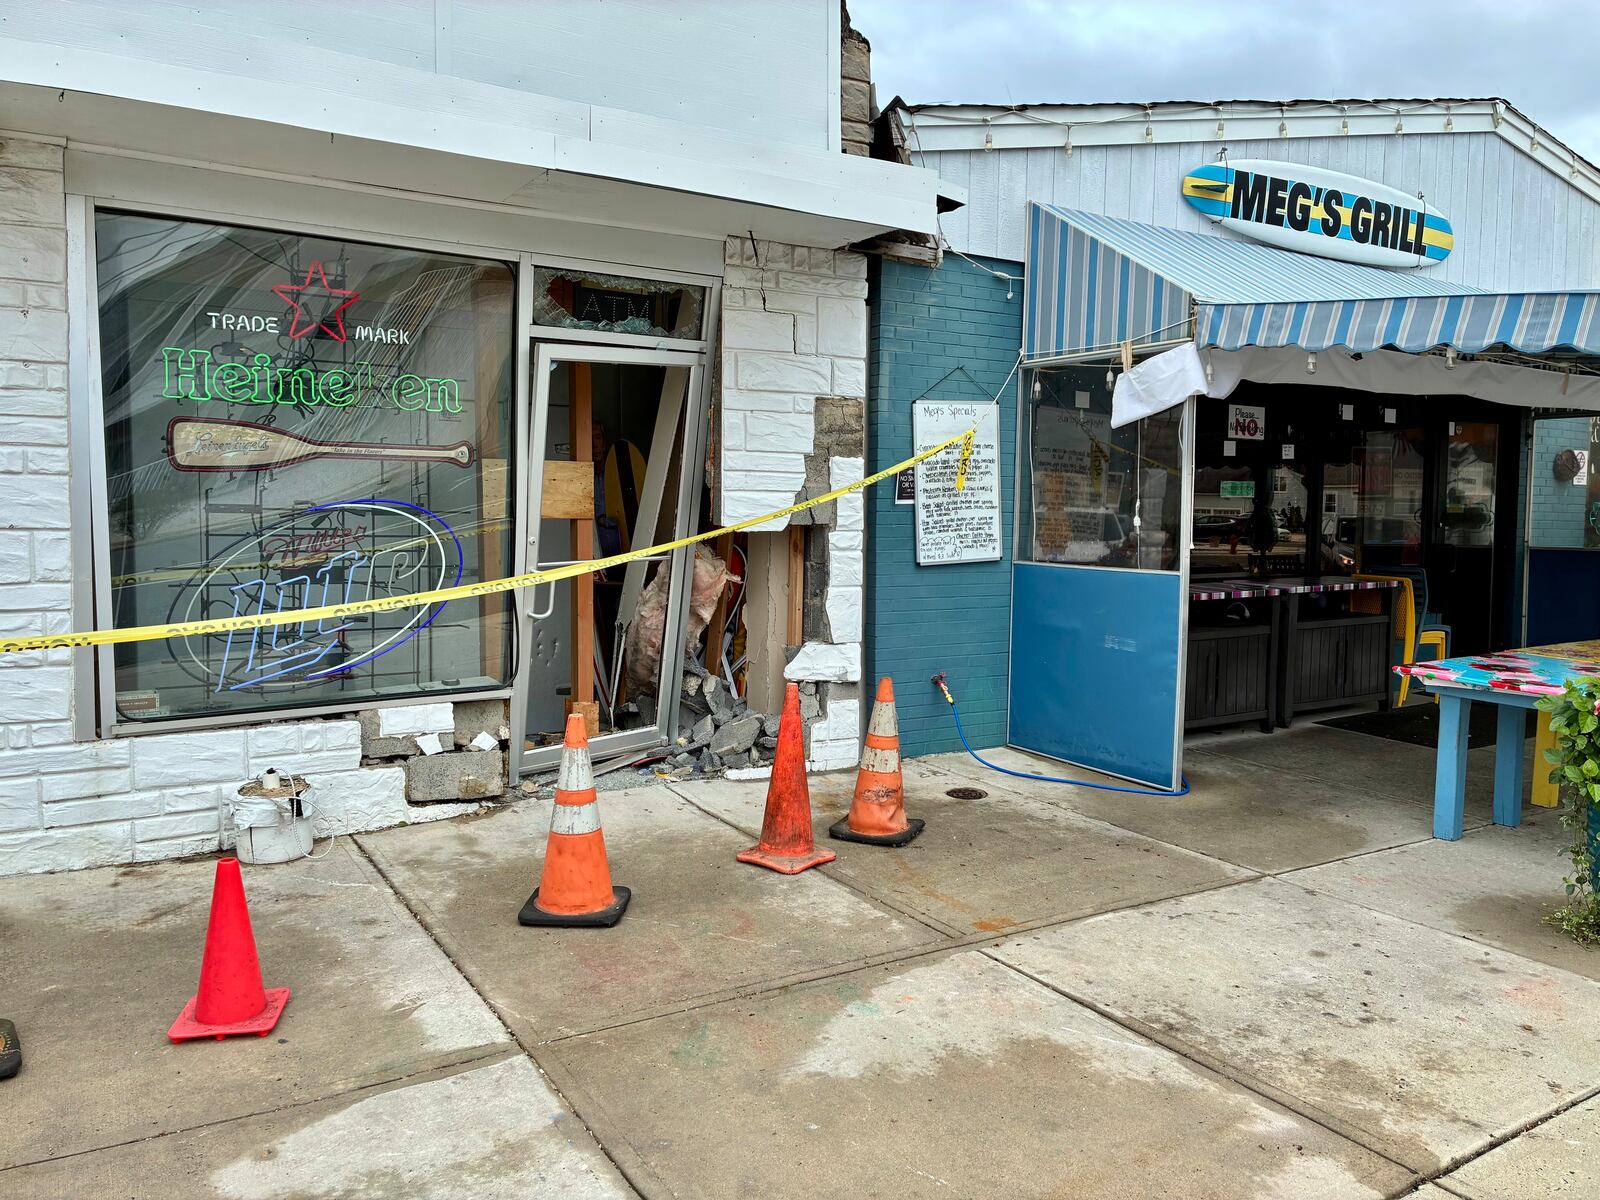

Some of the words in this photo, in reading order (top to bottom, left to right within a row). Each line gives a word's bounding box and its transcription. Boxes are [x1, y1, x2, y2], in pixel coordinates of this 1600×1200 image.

[1230, 170, 1344, 238] MEG'S
[1350, 196, 1428, 257] GRILL
[581, 294, 649, 322] ATM
[206, 312, 279, 334] TRADE
[355, 325, 410, 345] MARK
[161, 346, 463, 413] Heineken
[923, 406, 945, 422] Meg's
[1235, 418, 1258, 437] NO
